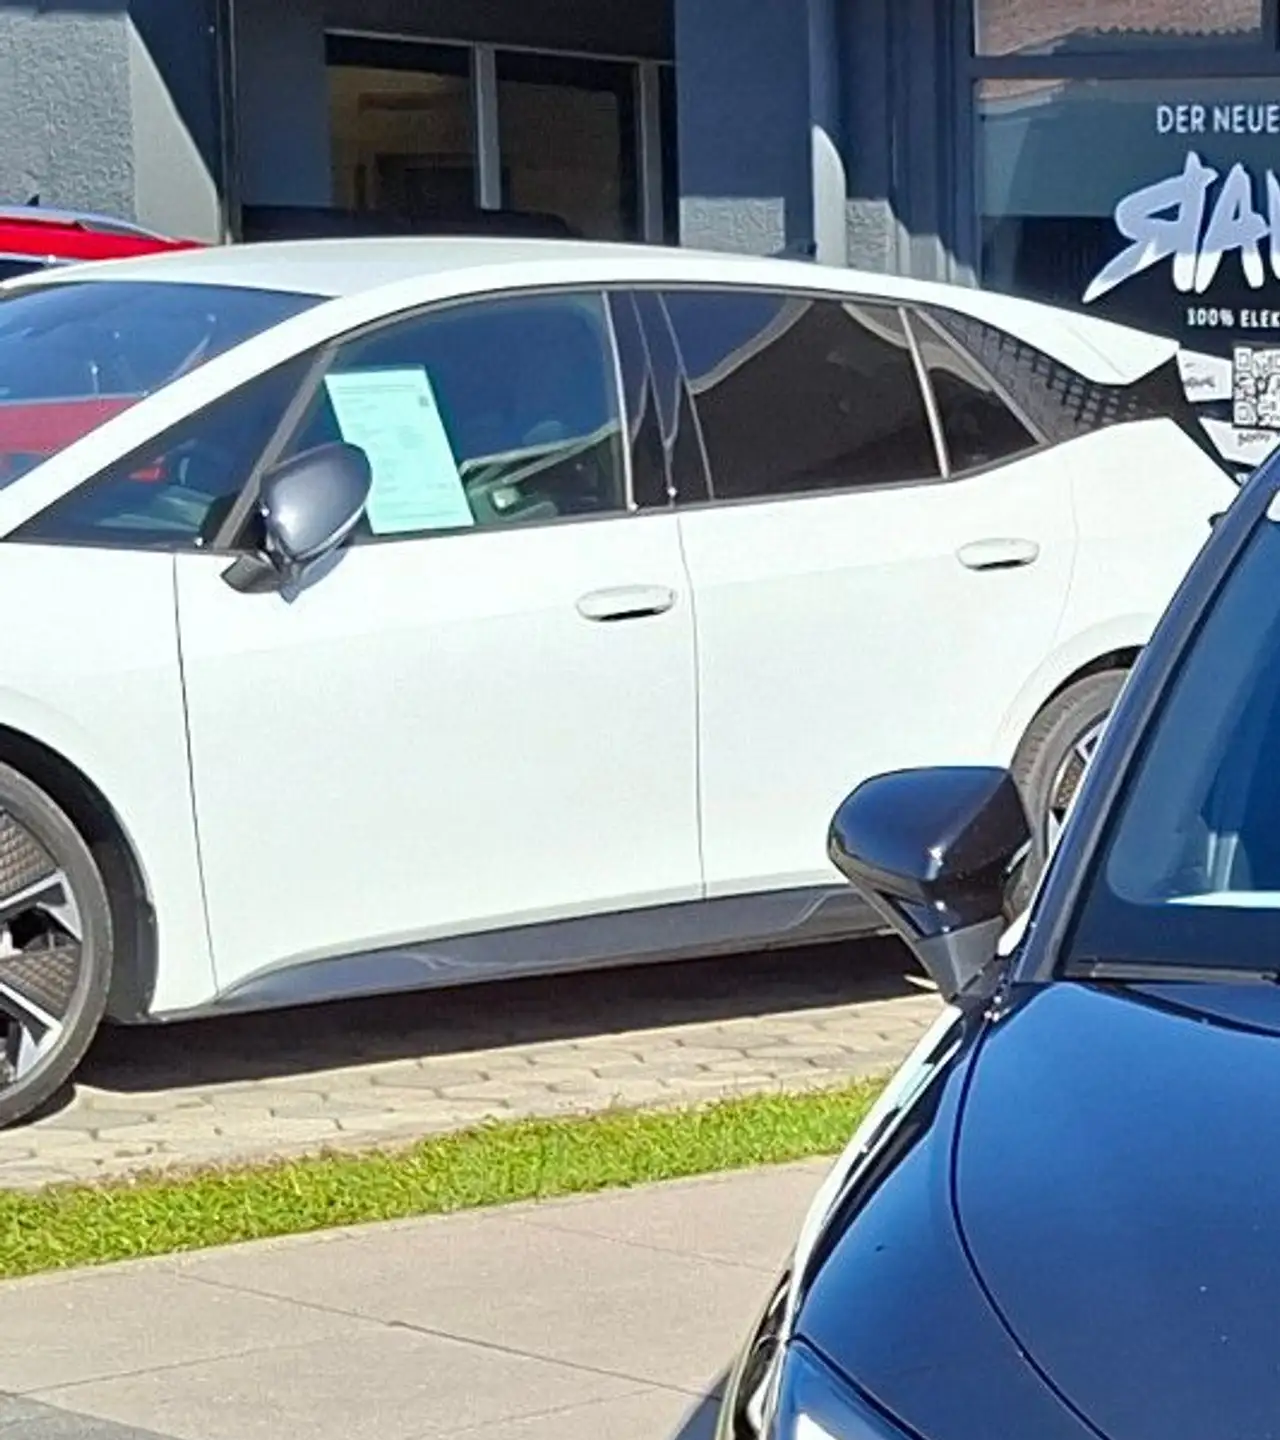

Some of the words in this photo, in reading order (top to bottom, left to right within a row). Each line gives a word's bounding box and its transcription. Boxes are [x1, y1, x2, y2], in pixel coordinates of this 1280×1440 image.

[1157, 105, 1206, 133] DER
[1213, 105, 1280, 133] NEUE
[1187, 308, 1234, 326] 100%
